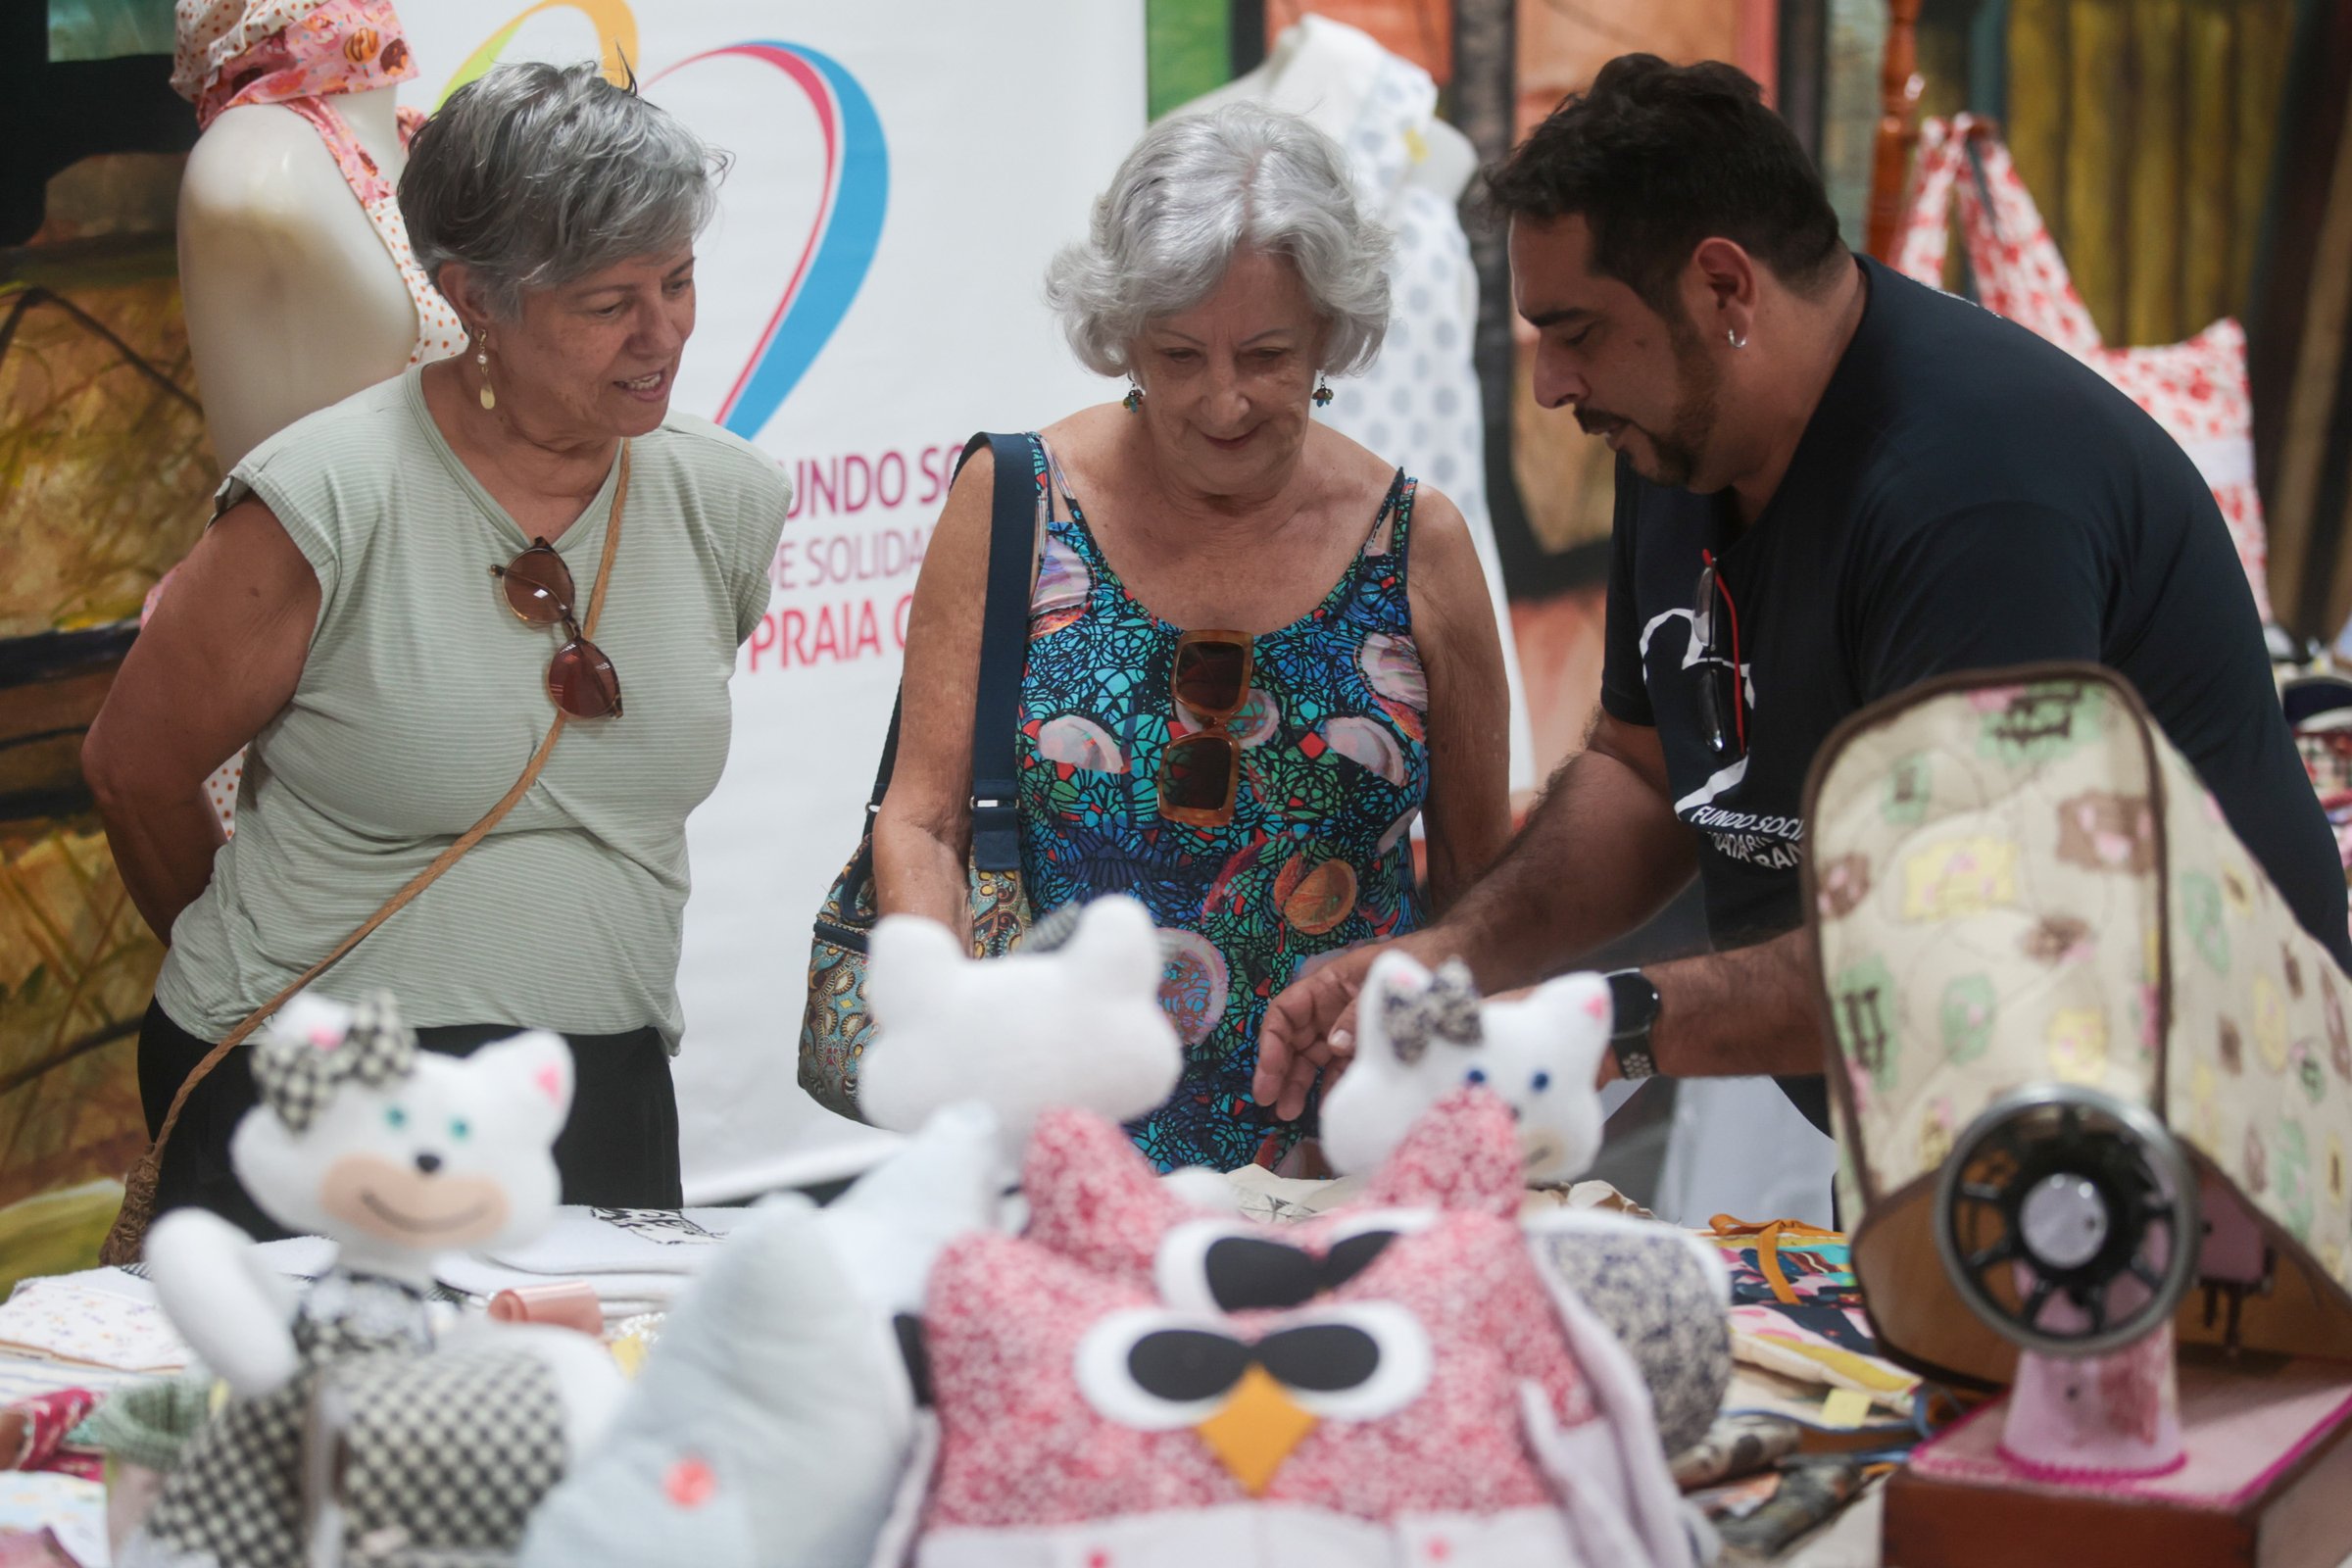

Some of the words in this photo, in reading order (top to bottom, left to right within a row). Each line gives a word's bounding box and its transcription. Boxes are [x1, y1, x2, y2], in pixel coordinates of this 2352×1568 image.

[780, 450, 907, 520] UNDO
[748, 599, 882, 673] PRAIA
[1690, 805, 1758, 829] FUNDO
